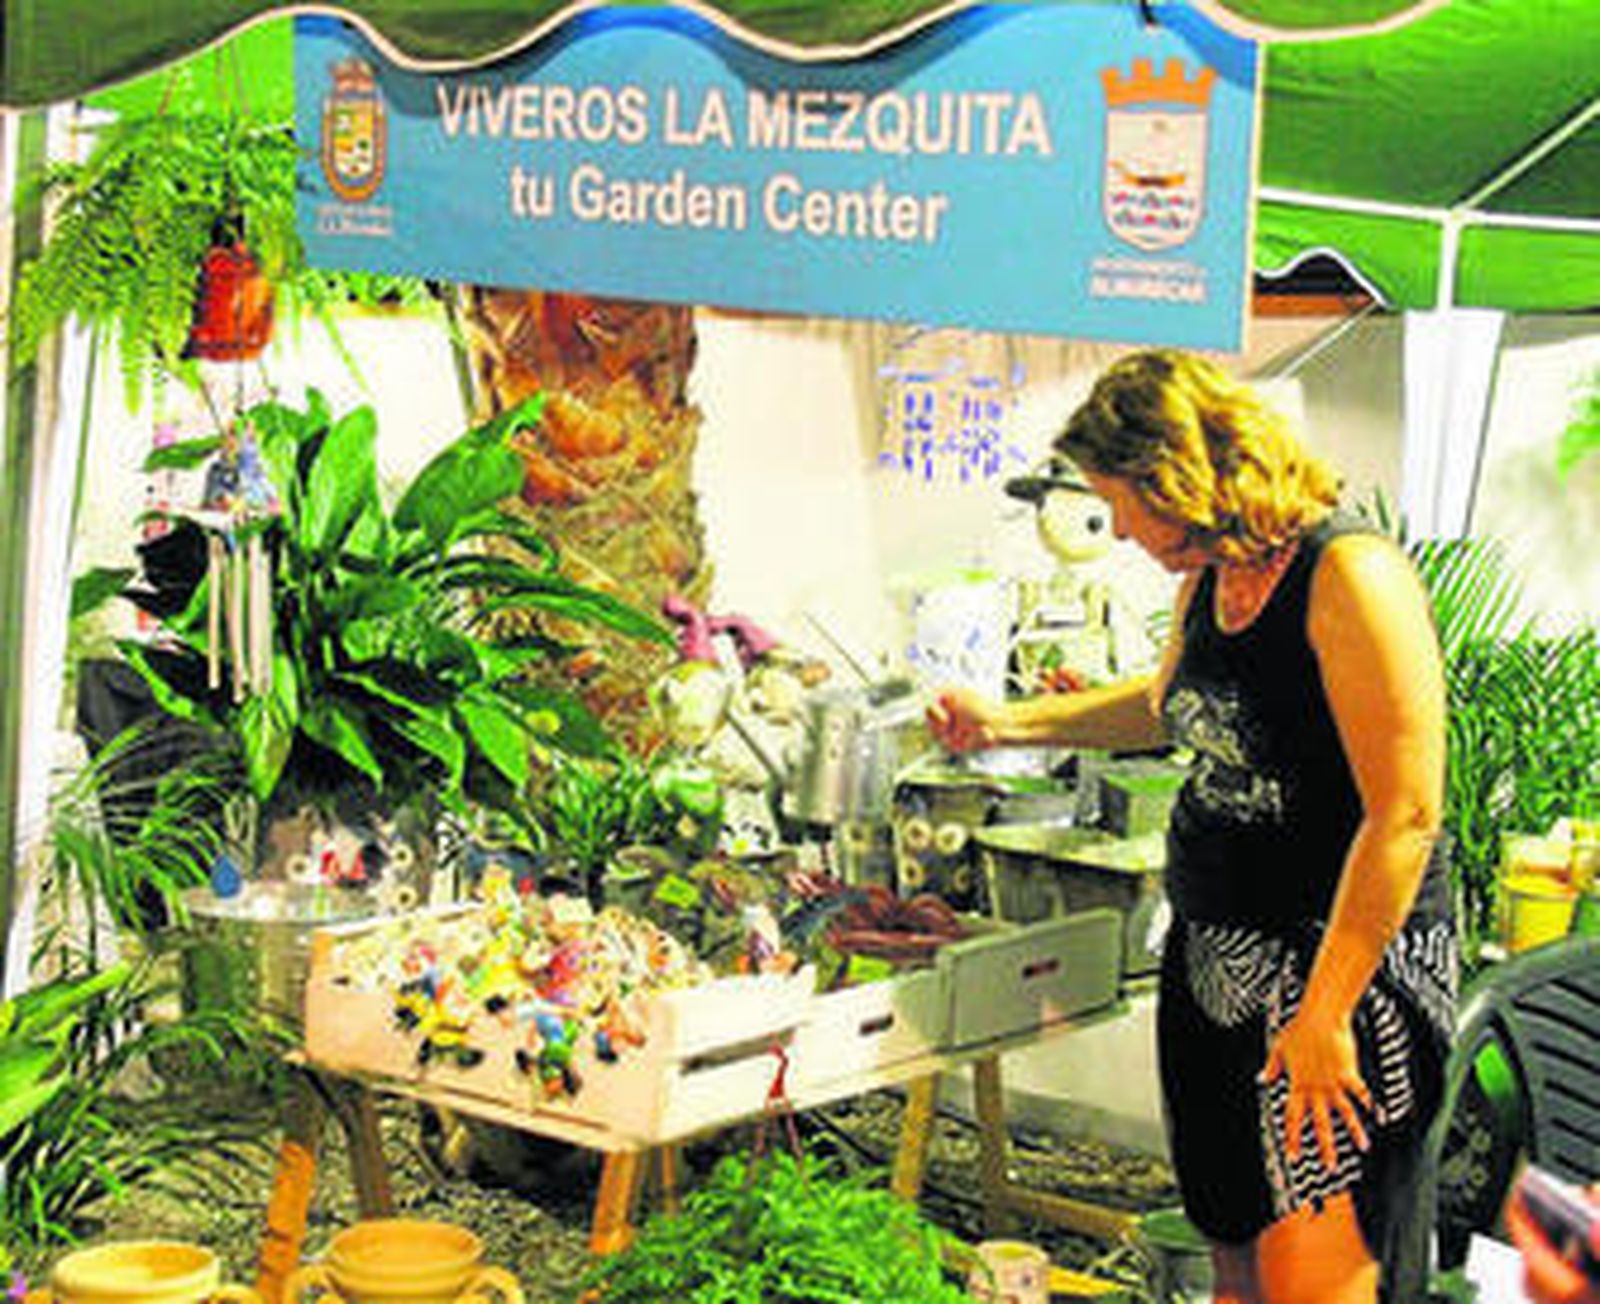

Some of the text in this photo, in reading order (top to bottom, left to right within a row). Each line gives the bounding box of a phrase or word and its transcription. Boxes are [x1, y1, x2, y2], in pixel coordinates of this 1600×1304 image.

[437, 83, 1053, 157] VIVEROS LA MEZQUITA
[510, 164, 949, 242] tu Garden Center
